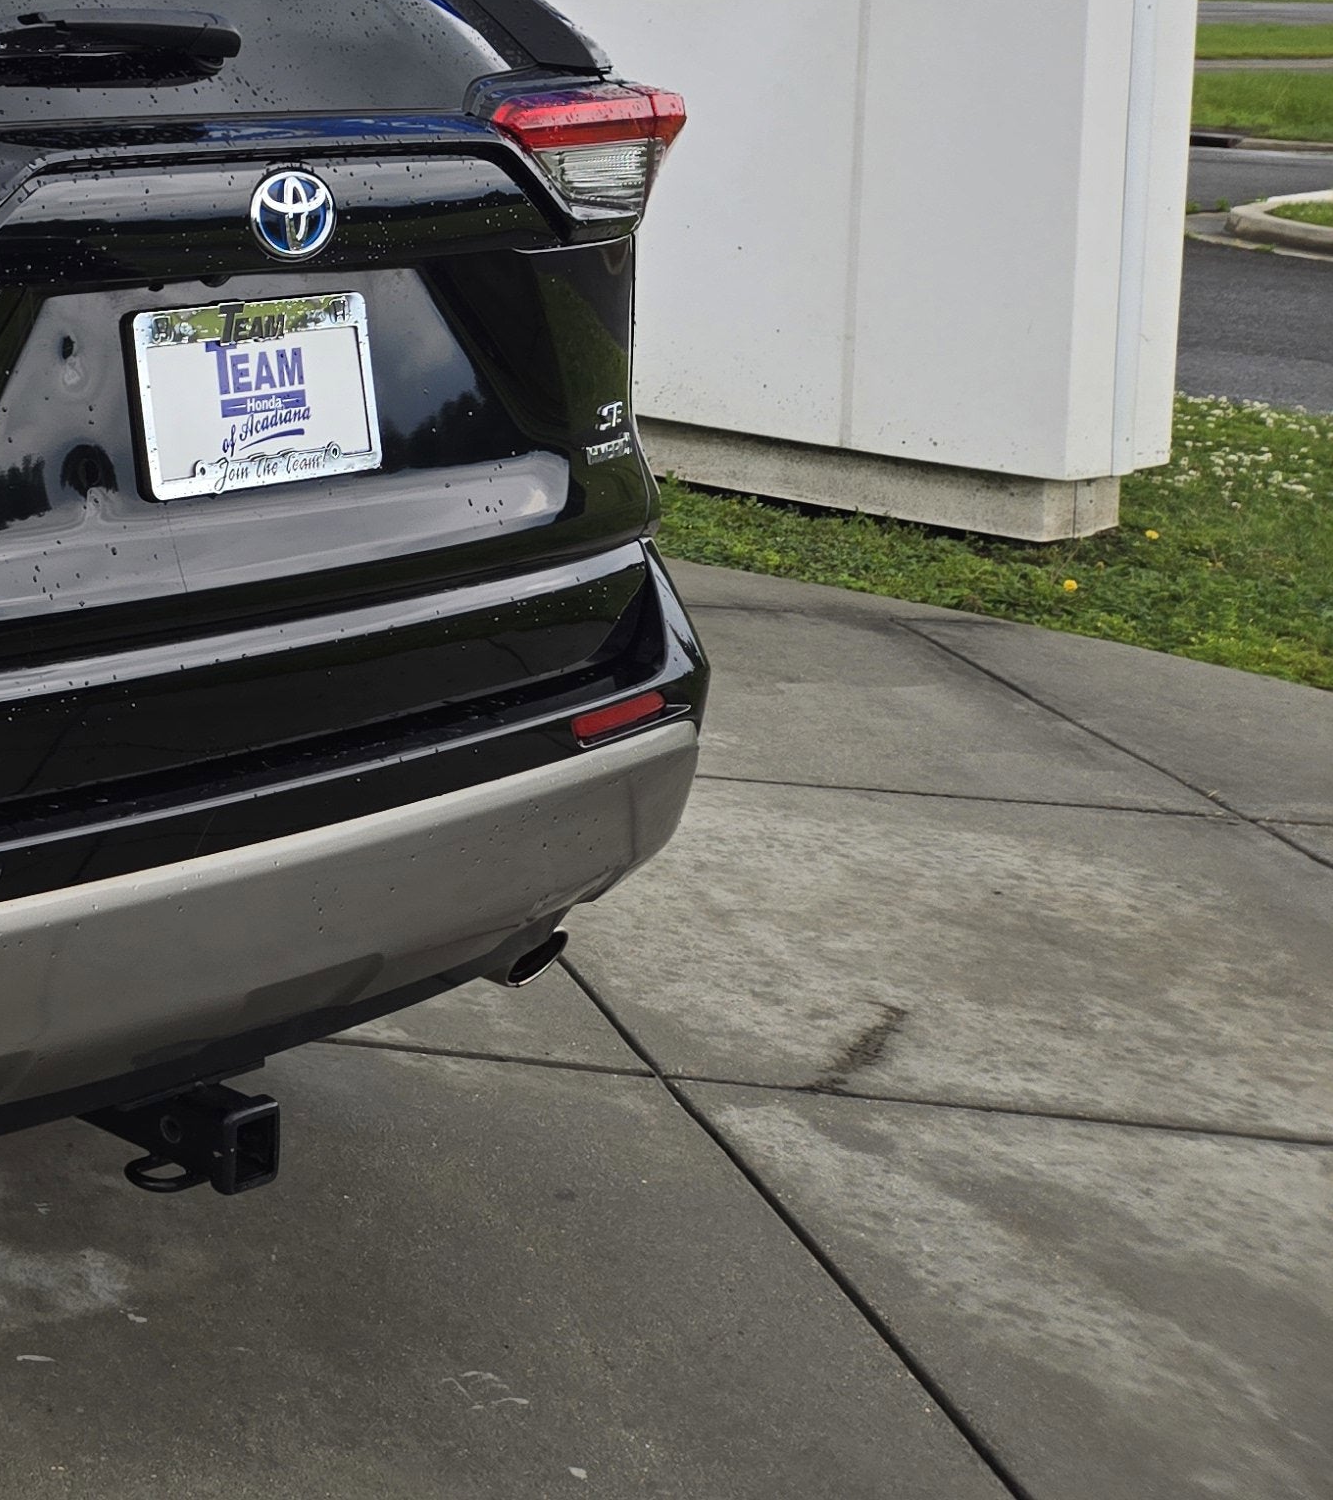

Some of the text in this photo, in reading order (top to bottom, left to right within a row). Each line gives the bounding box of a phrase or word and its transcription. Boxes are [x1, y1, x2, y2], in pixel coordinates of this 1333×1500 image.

[217, 301, 286, 346] TEAM
[205, 340, 305, 395] TEAM
[246, 394, 283, 413] Honda
[222, 406, 312, 457] of Acadiana
[214, 456, 249, 492] Join
[256, 457, 279, 478] The
